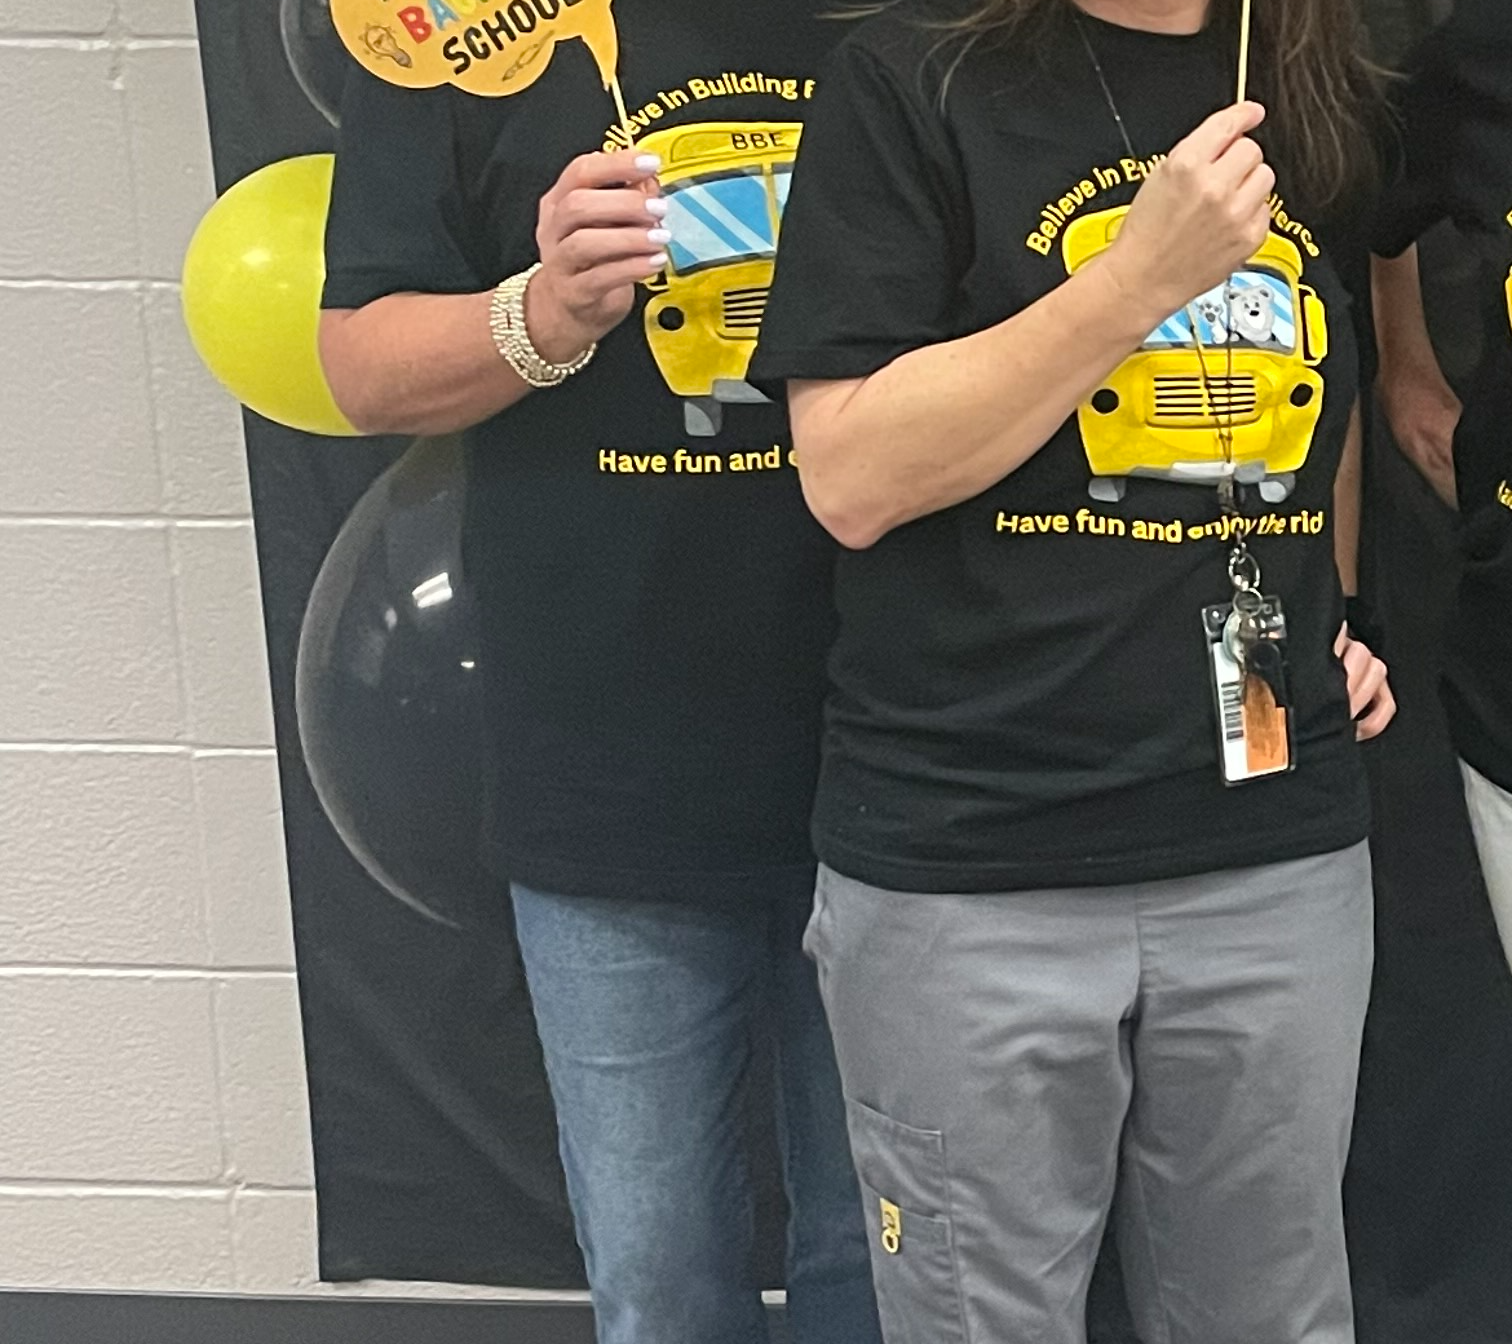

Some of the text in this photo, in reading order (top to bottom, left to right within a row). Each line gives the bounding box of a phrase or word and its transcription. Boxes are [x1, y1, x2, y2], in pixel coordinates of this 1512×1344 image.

[658, 89, 690, 110] in
[687, 72, 798, 101] Building
[731, 132, 785, 150] BBE
[1025, 178, 1098, 256] Believe
[1093, 166, 1121, 190] in
[599, 449, 667, 473] Have
[673, 449, 722, 473] fun
[729, 444, 780, 471] and
[996, 511, 1069, 535] Have
[1075, 508, 1126, 536] fun
[1131, 519, 1183, 544] and
[1256, 513, 1287, 535] the
